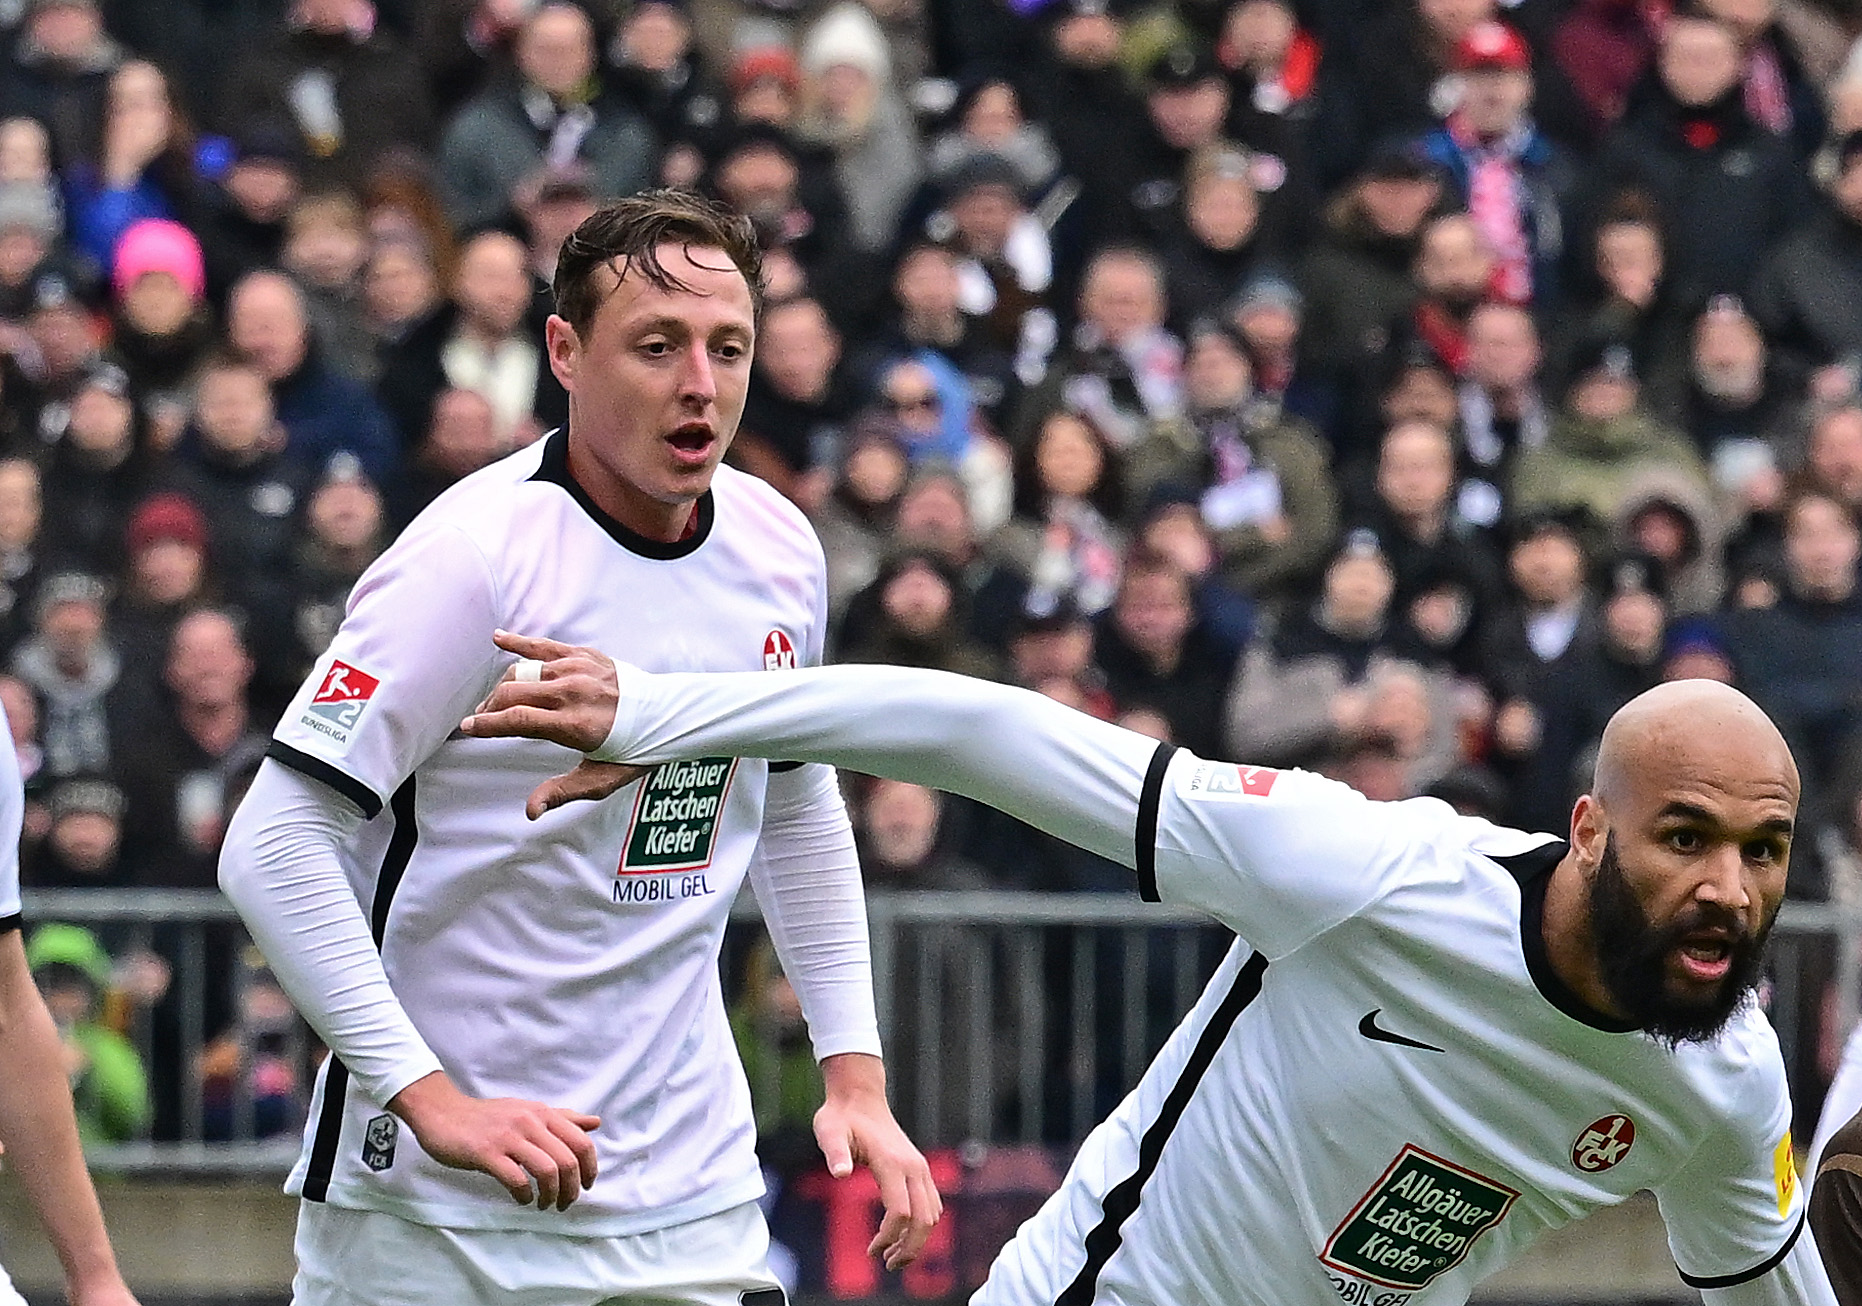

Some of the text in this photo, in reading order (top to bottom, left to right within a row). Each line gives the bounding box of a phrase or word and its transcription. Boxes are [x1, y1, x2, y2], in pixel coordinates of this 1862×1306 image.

[301, 715, 347, 743] BUNDESLIGA
[650, 762, 727, 795] Allgäuer
[640, 790, 718, 824] Latschen
[645, 825, 700, 856] Kiefer
[612, 874, 716, 903] MOBIL GEL
[1389, 1169, 1493, 1226] Allgäuer
[1365, 1195, 1467, 1255] Latschen
[1357, 1231, 1431, 1274] Kiefer
